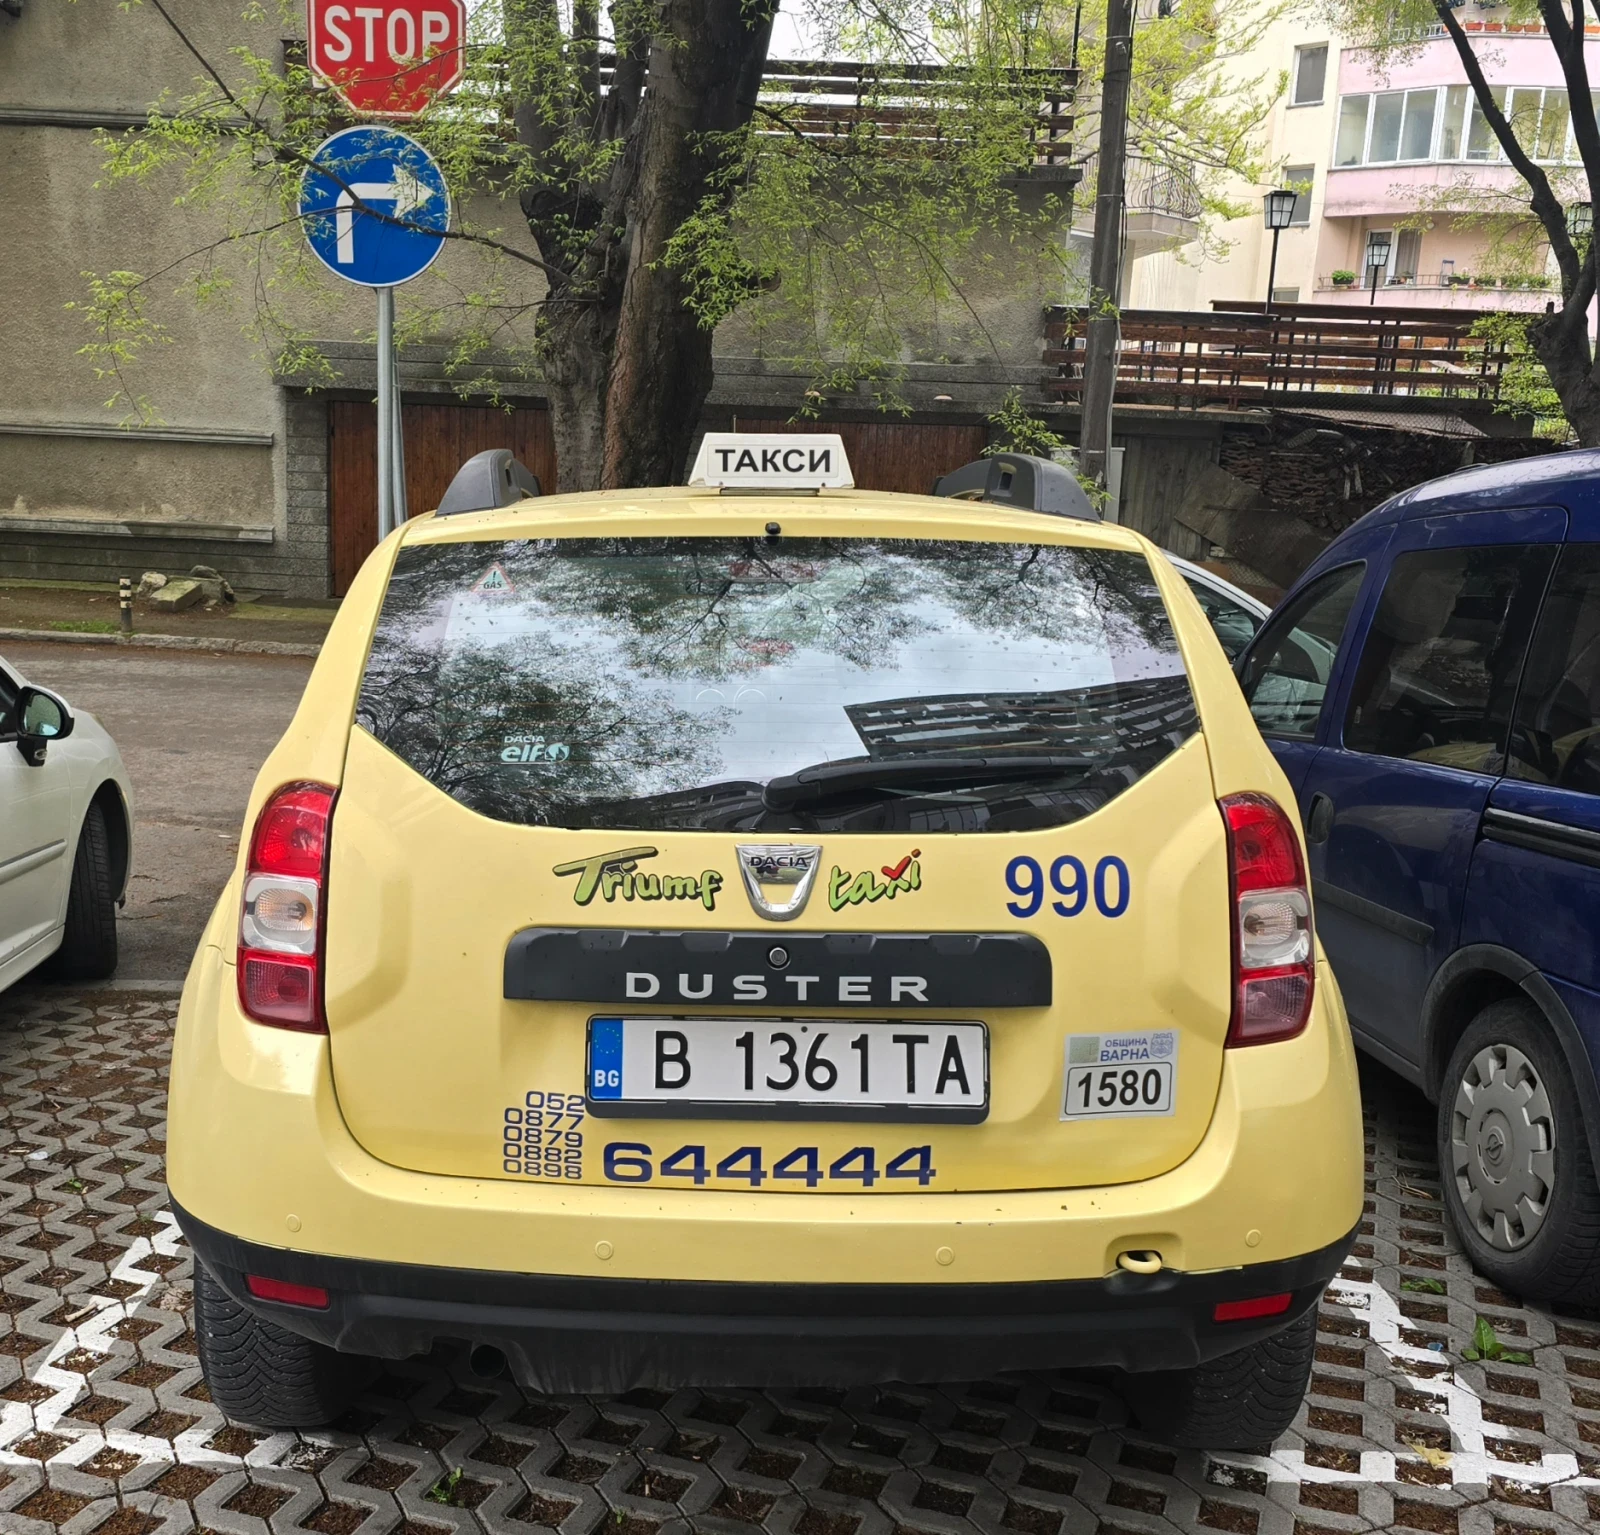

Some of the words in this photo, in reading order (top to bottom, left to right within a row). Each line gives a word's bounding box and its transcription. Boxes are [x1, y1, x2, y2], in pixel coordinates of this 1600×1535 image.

[324, 5, 450, 65] STOP
[715, 449, 831, 473] ТАКСИ
[483, 580, 502, 590] GAS
[504, 735, 545, 743] DACIA
[501, 744, 545, 762] elf
[750, 856, 808, 867] DACIA
[552, 846, 724, 912] Triumf
[828, 848, 922, 912] taxi
[1004, 855, 1130, 918] 990
[625, 972, 929, 1002] DUSTER
[1105, 1038, 1148, 1047] ОБЩИНА
[1100, 1048, 1149, 1062] ВАРНА
[594, 1069, 619, 1087] BG
[1077, 1068, 1162, 1108] 1580
[525, 1090, 586, 1113] 052
[504, 1107, 585, 1130] 0877
[503, 1125, 583, 1148] 0879
[503, 1142, 582, 1165] 0882
[603, 1142, 937, 1188] 644444
[503, 1159, 582, 1180] 0898
